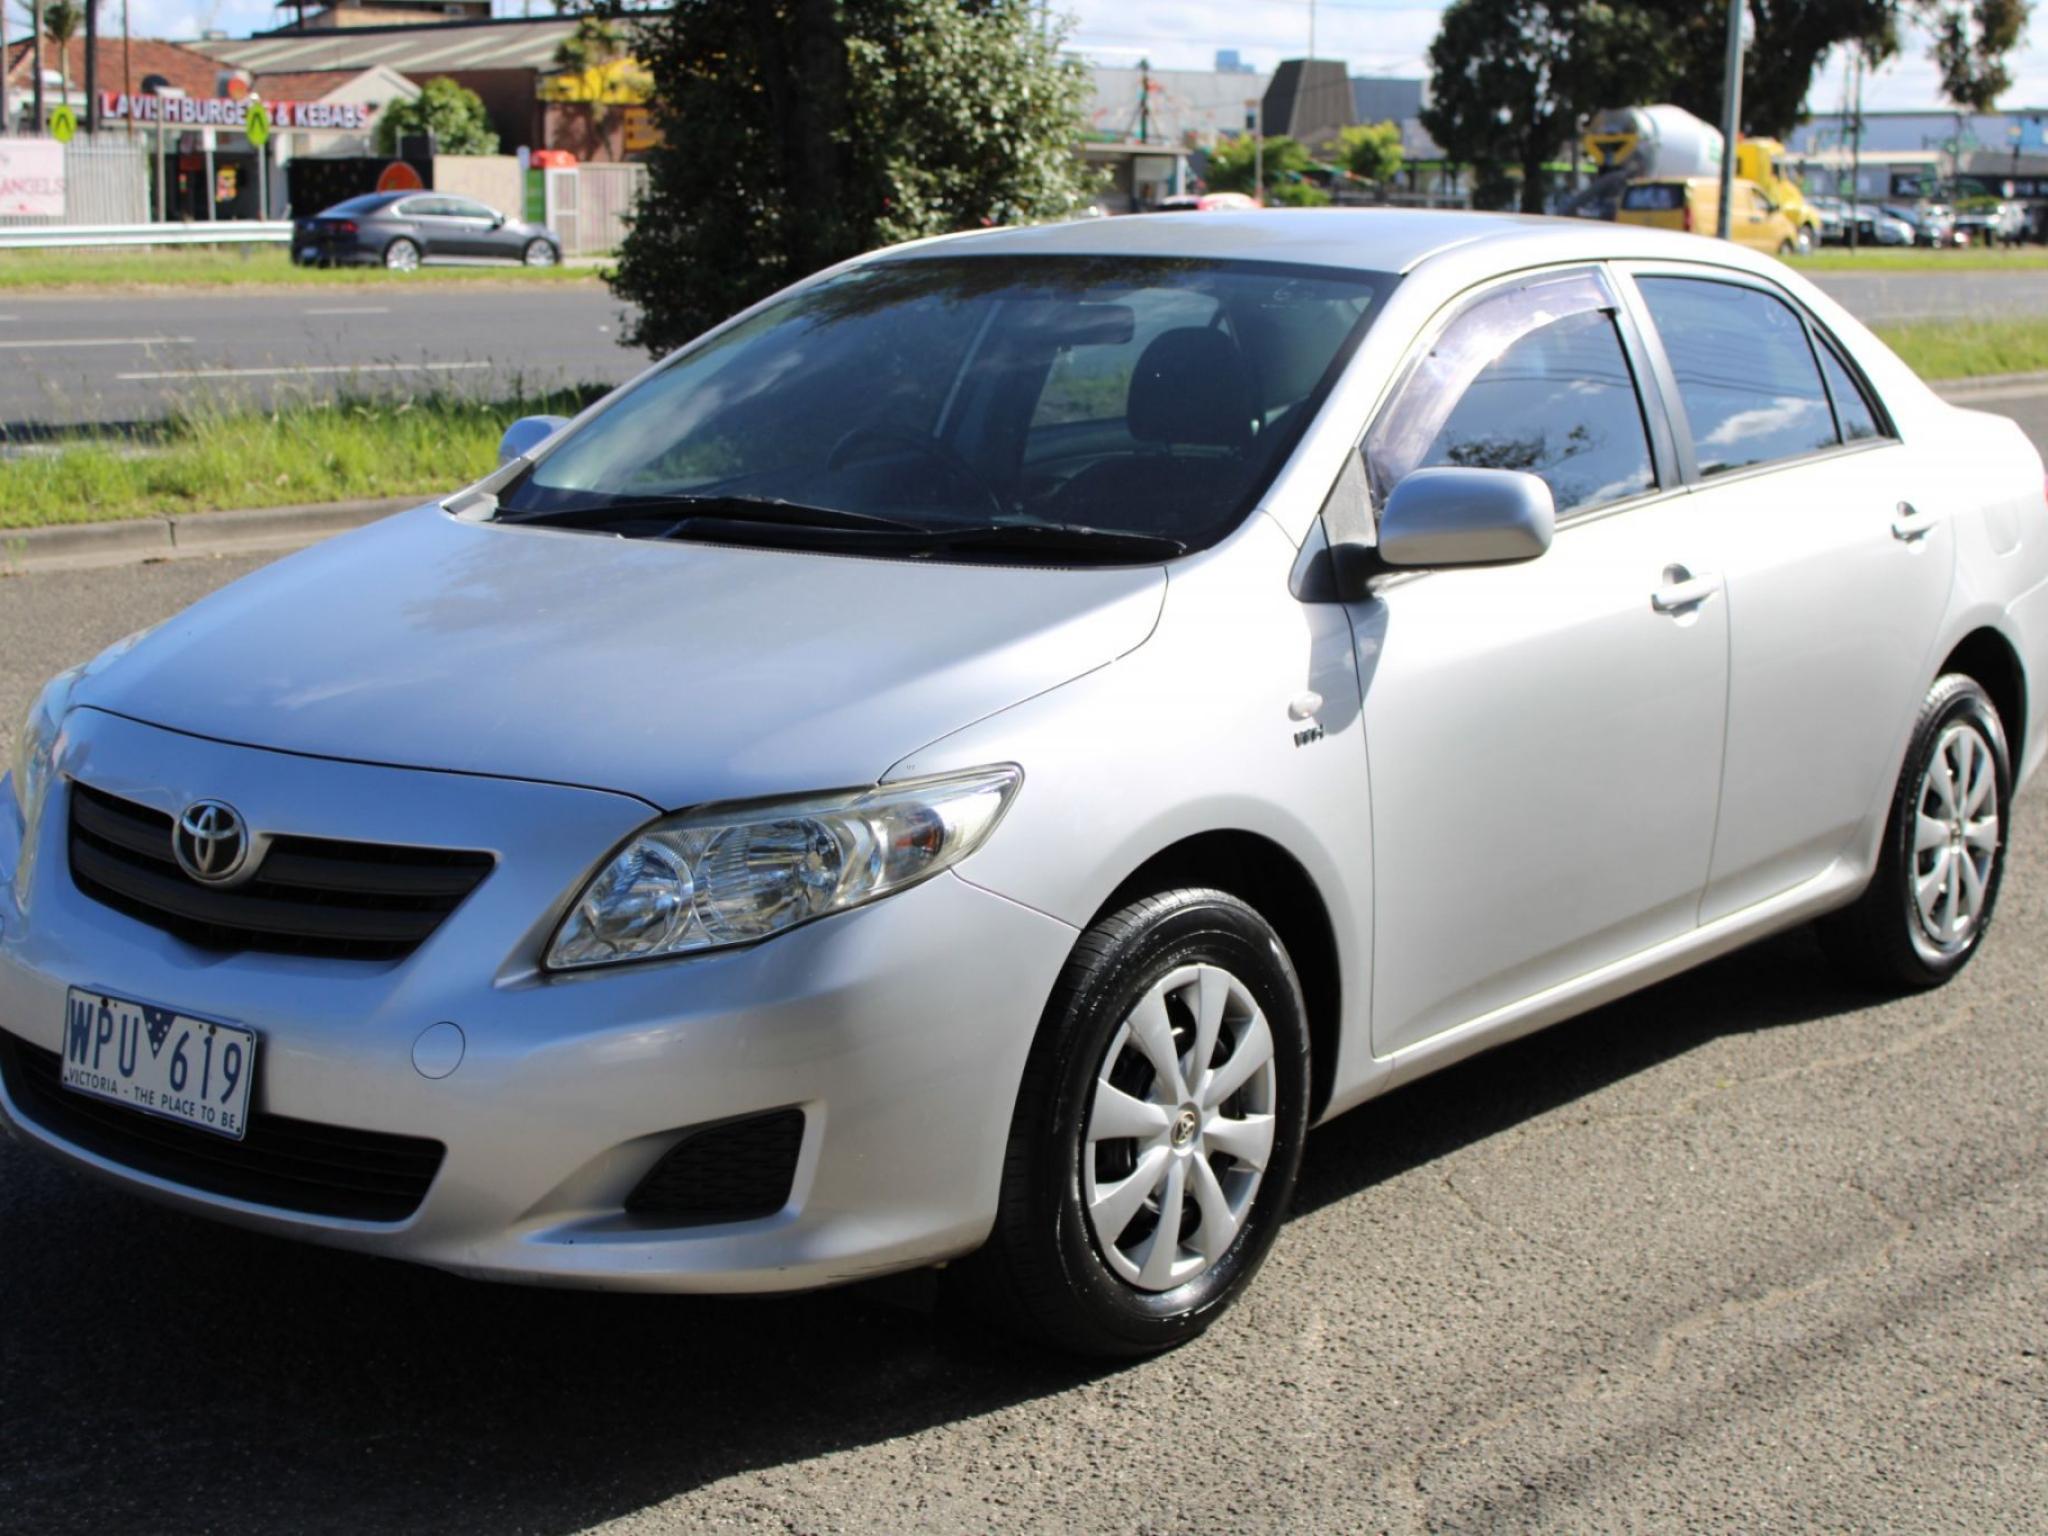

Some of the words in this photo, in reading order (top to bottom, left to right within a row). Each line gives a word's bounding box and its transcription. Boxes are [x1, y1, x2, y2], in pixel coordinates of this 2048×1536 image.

[184, 97, 273, 126] BURGES
[276, 101, 289, 126] &
[294, 101, 369, 128] KEBABS
[69, 997, 140, 1078] WPU
[169, 1030, 242, 1104] 619
[68, 1067, 118, 1094] VICTORIA
[134, 1085, 155, 1106] THE
[160, 1093, 195, 1117] PLACE
[201, 1105, 215, 1123] TO
[221, 1113, 235, 1130] BE
